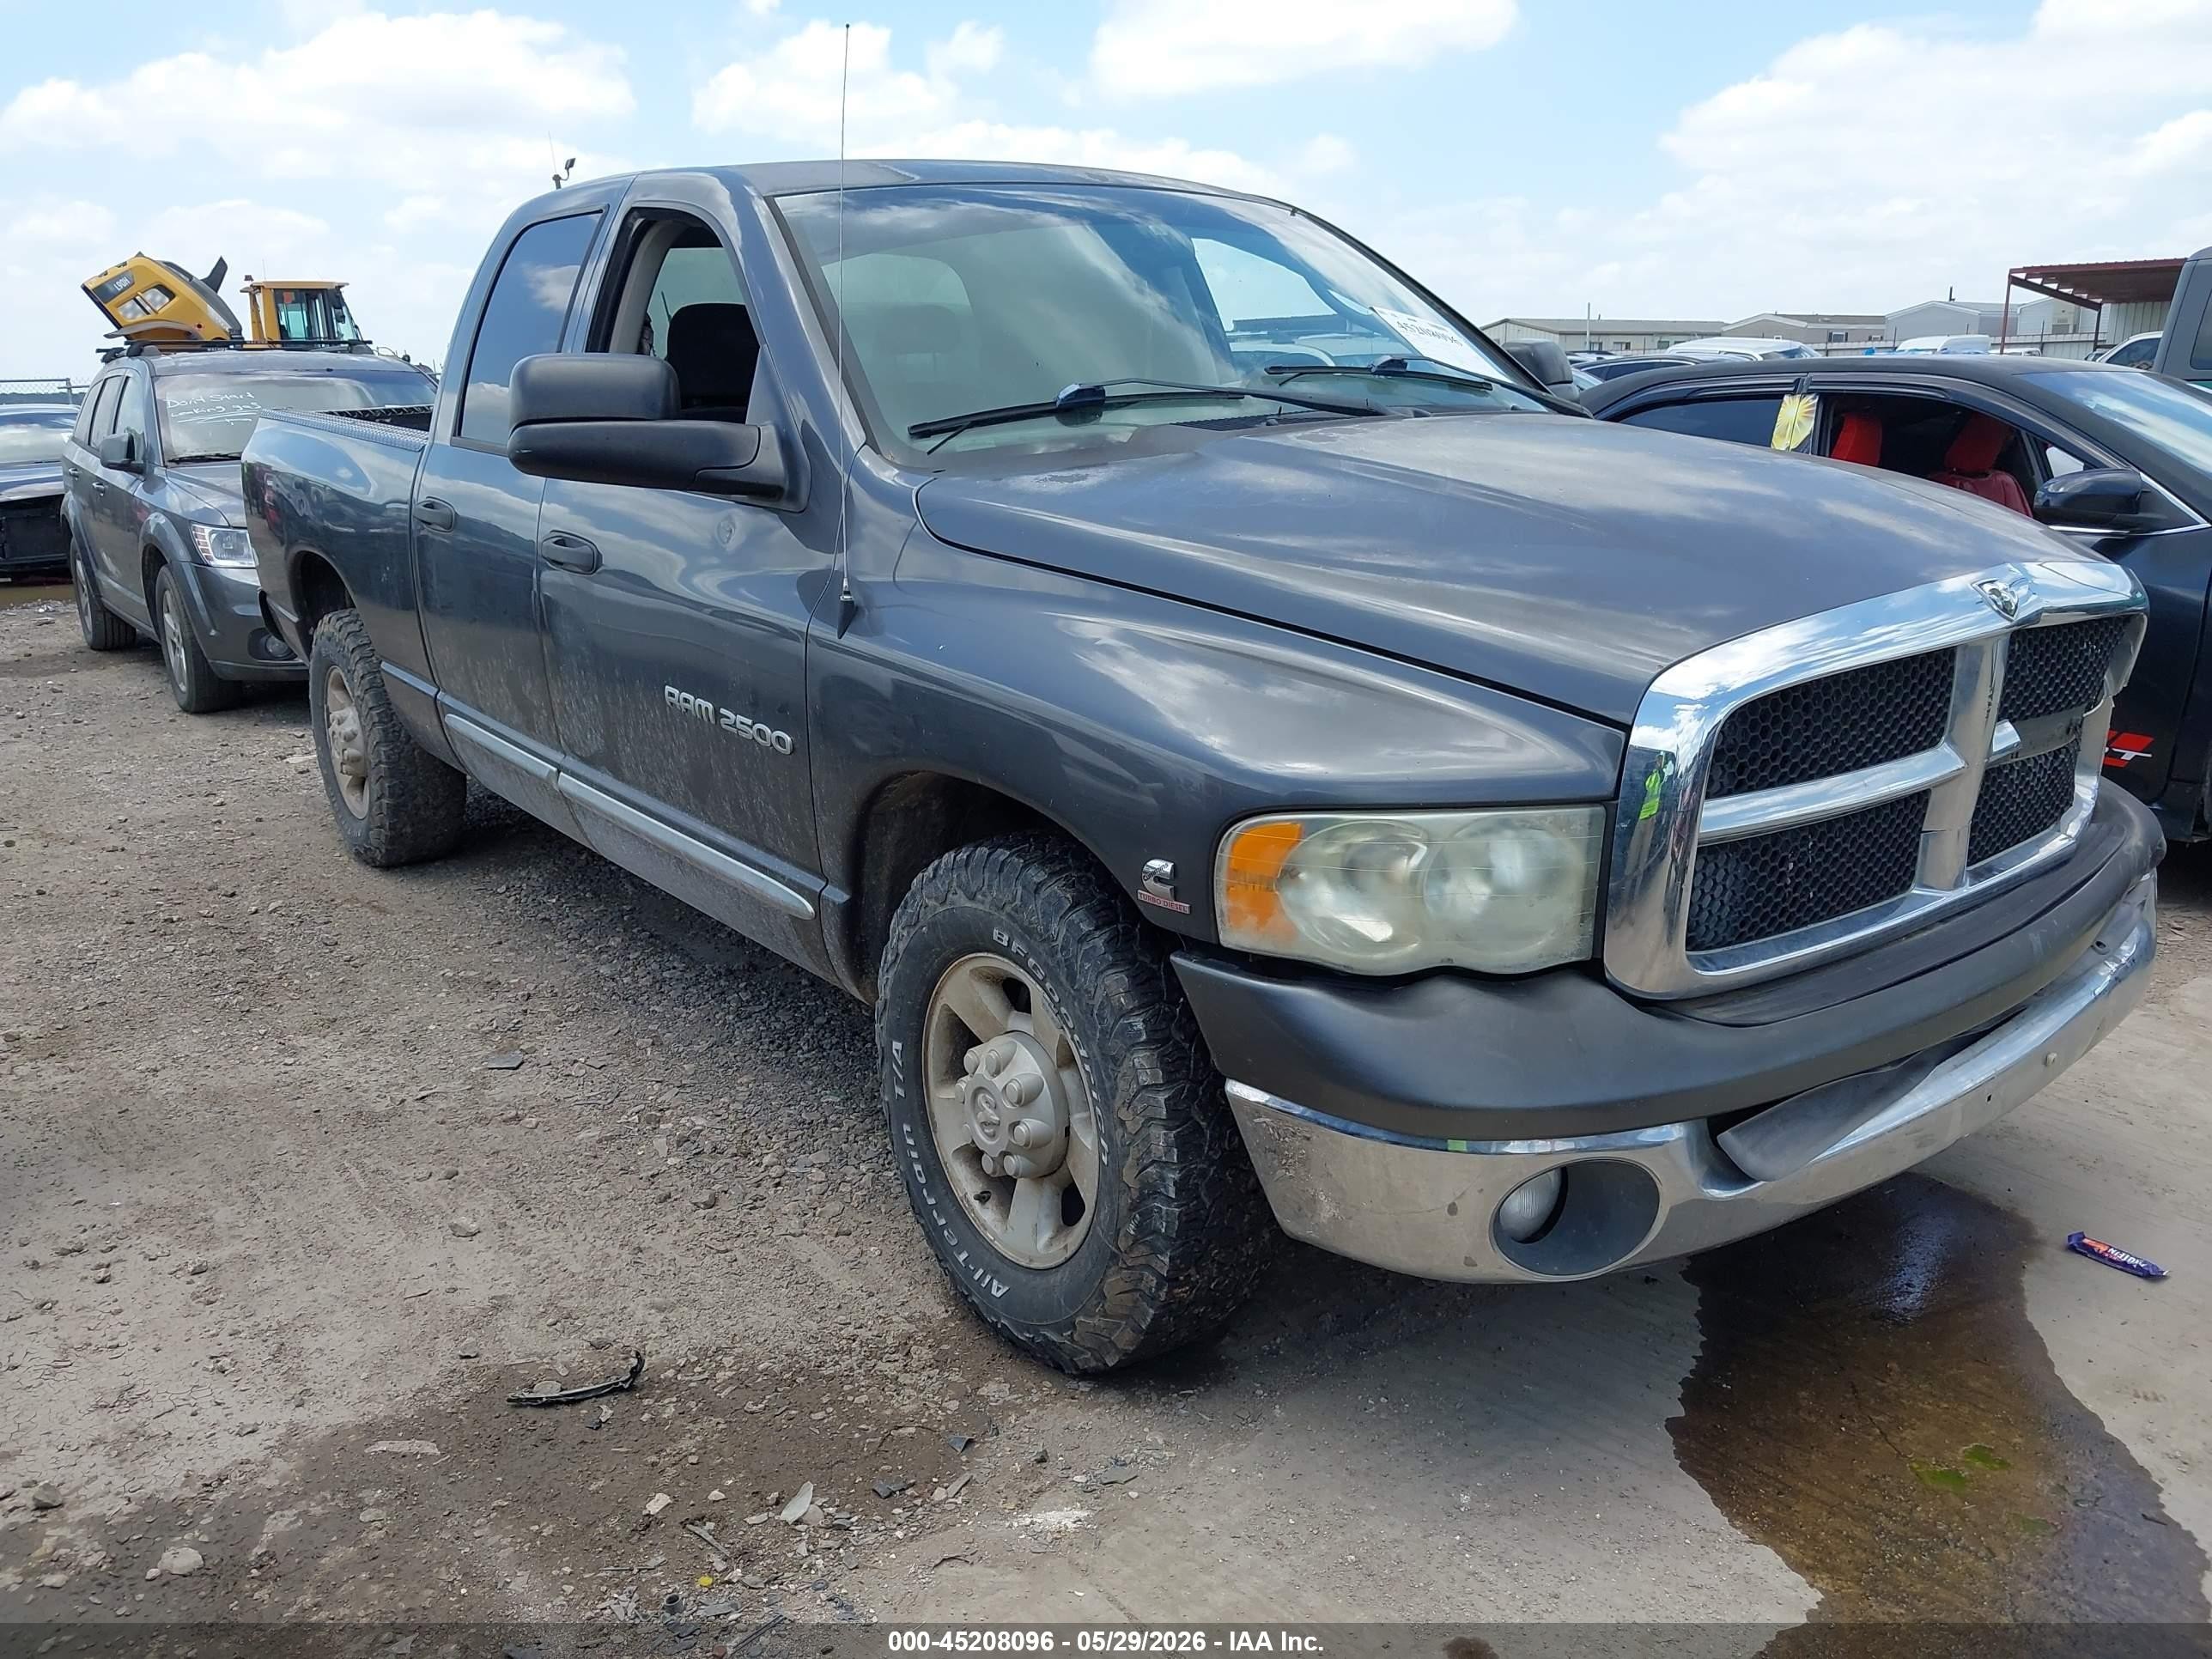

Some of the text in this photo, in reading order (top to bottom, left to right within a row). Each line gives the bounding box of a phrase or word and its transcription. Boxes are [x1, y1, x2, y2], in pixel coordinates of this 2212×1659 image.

[664, 684, 793, 756] RAM 2500
[891, 1040, 1011, 1298] All-Terrain T/A
